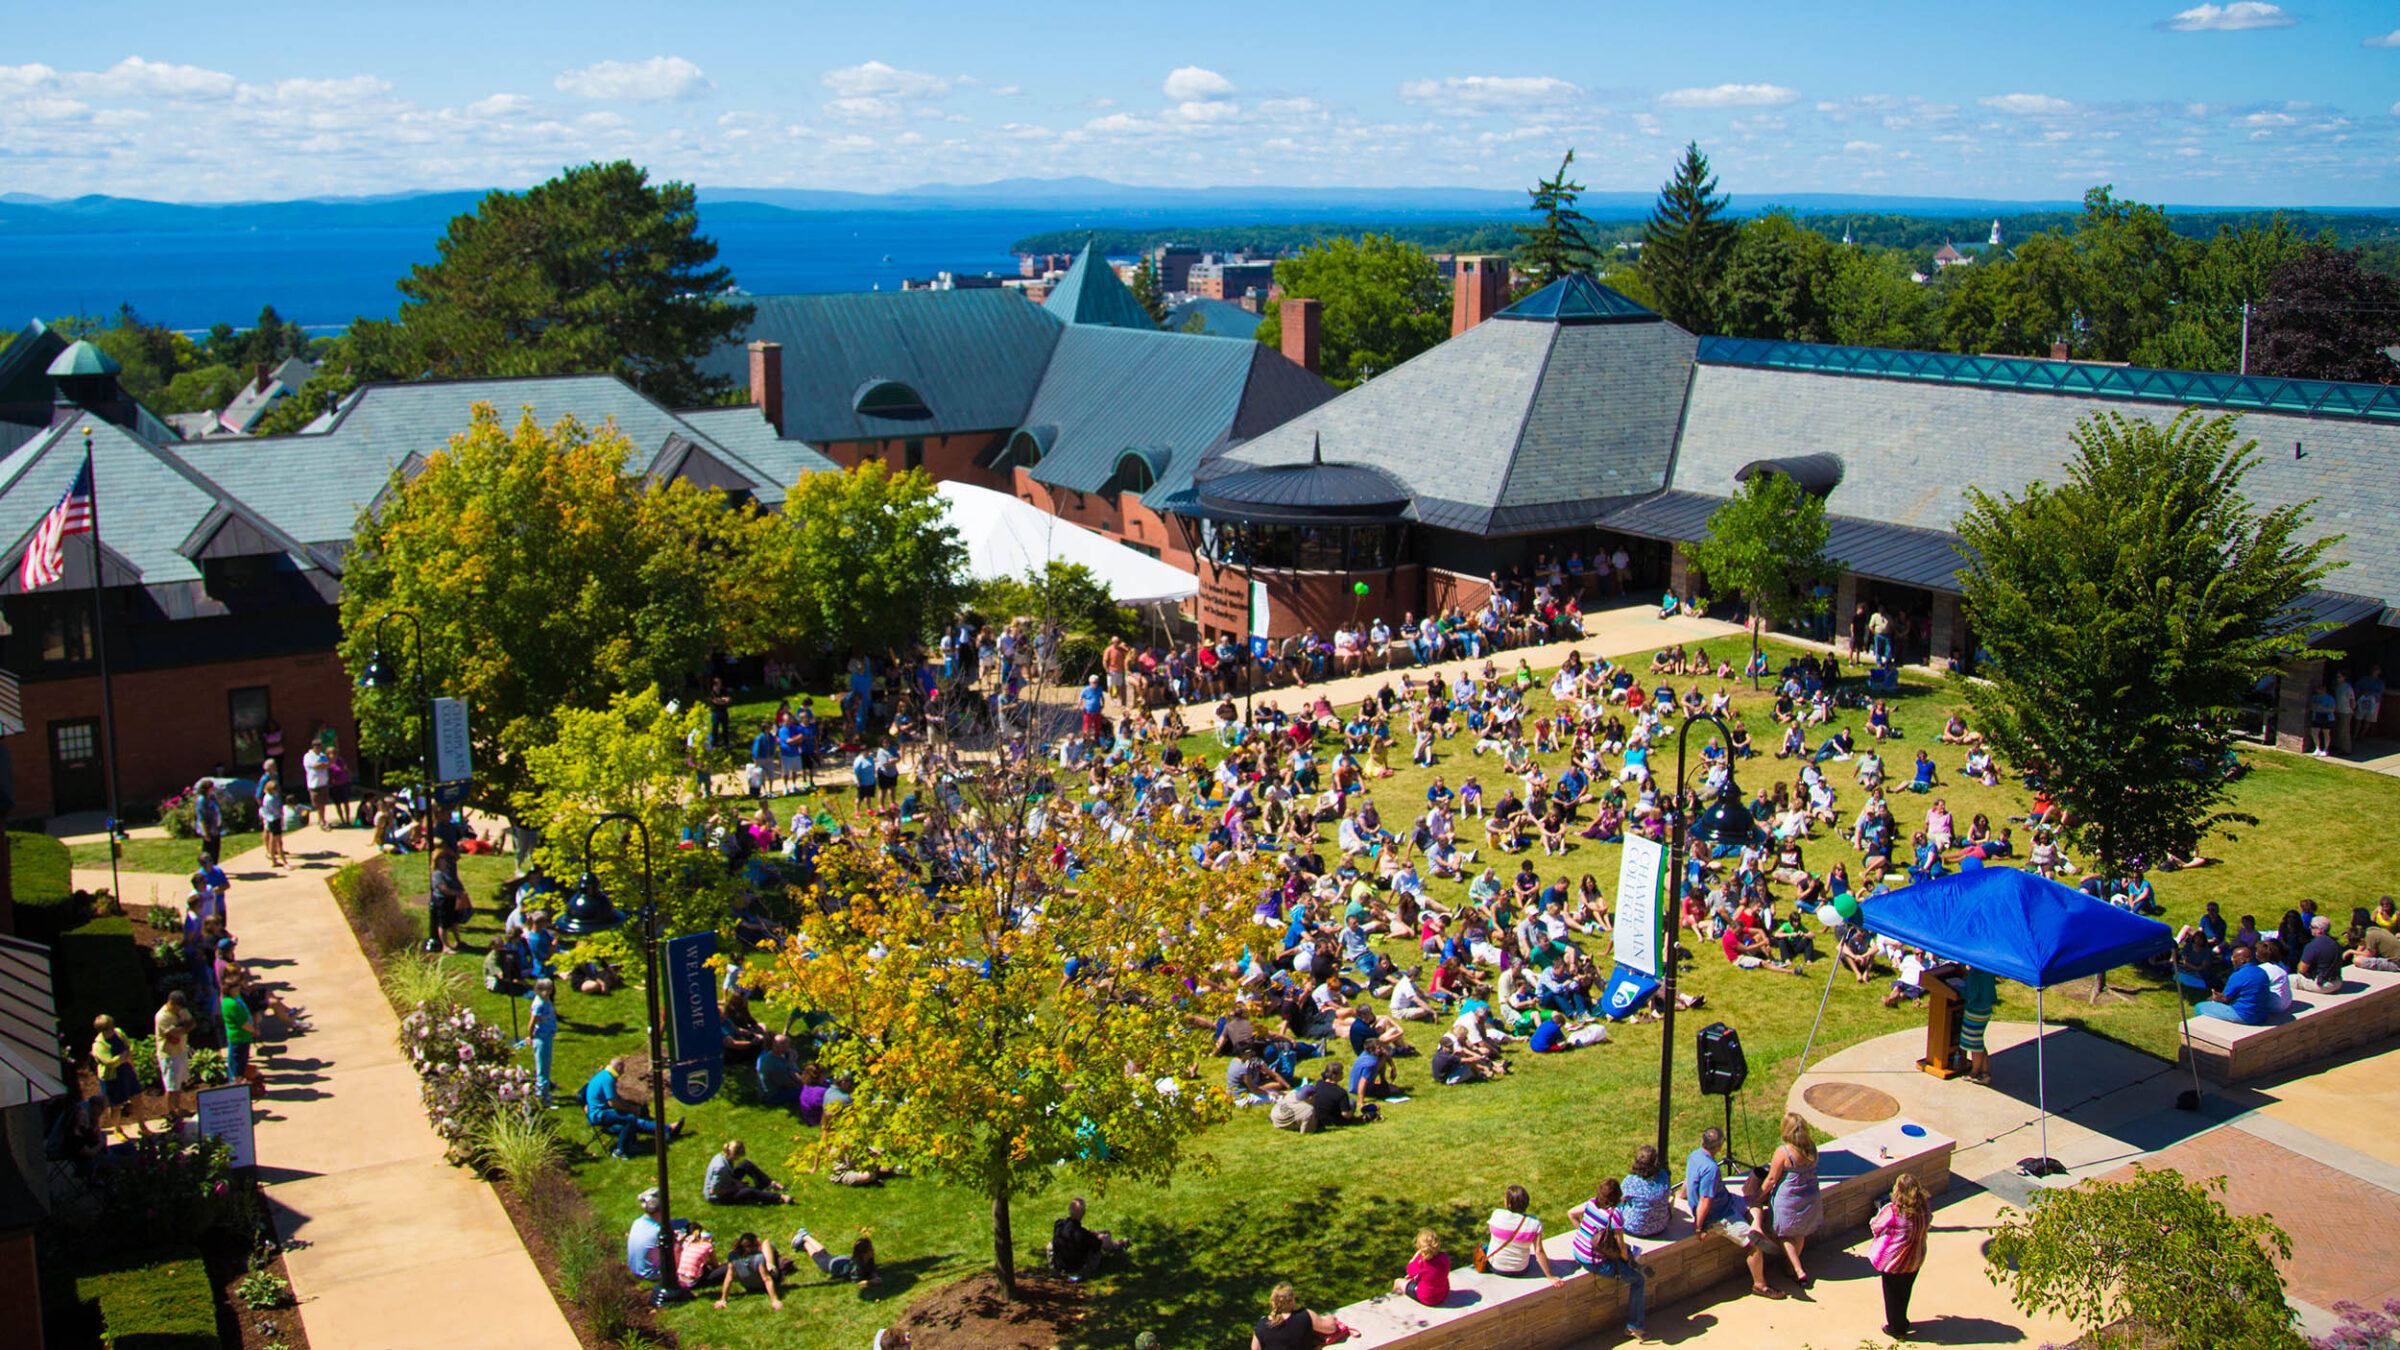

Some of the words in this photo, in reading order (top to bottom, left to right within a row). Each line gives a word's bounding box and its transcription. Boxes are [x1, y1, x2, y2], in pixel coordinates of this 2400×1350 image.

[443, 704, 454, 754] COLLEGE
[453, 703, 466, 773] CHAMPLAIN
[1621, 847, 1639, 929] COLLEGE
[1633, 851, 1650, 960] CHAMPLAIN
[686, 944, 704, 1030] WELCOME
